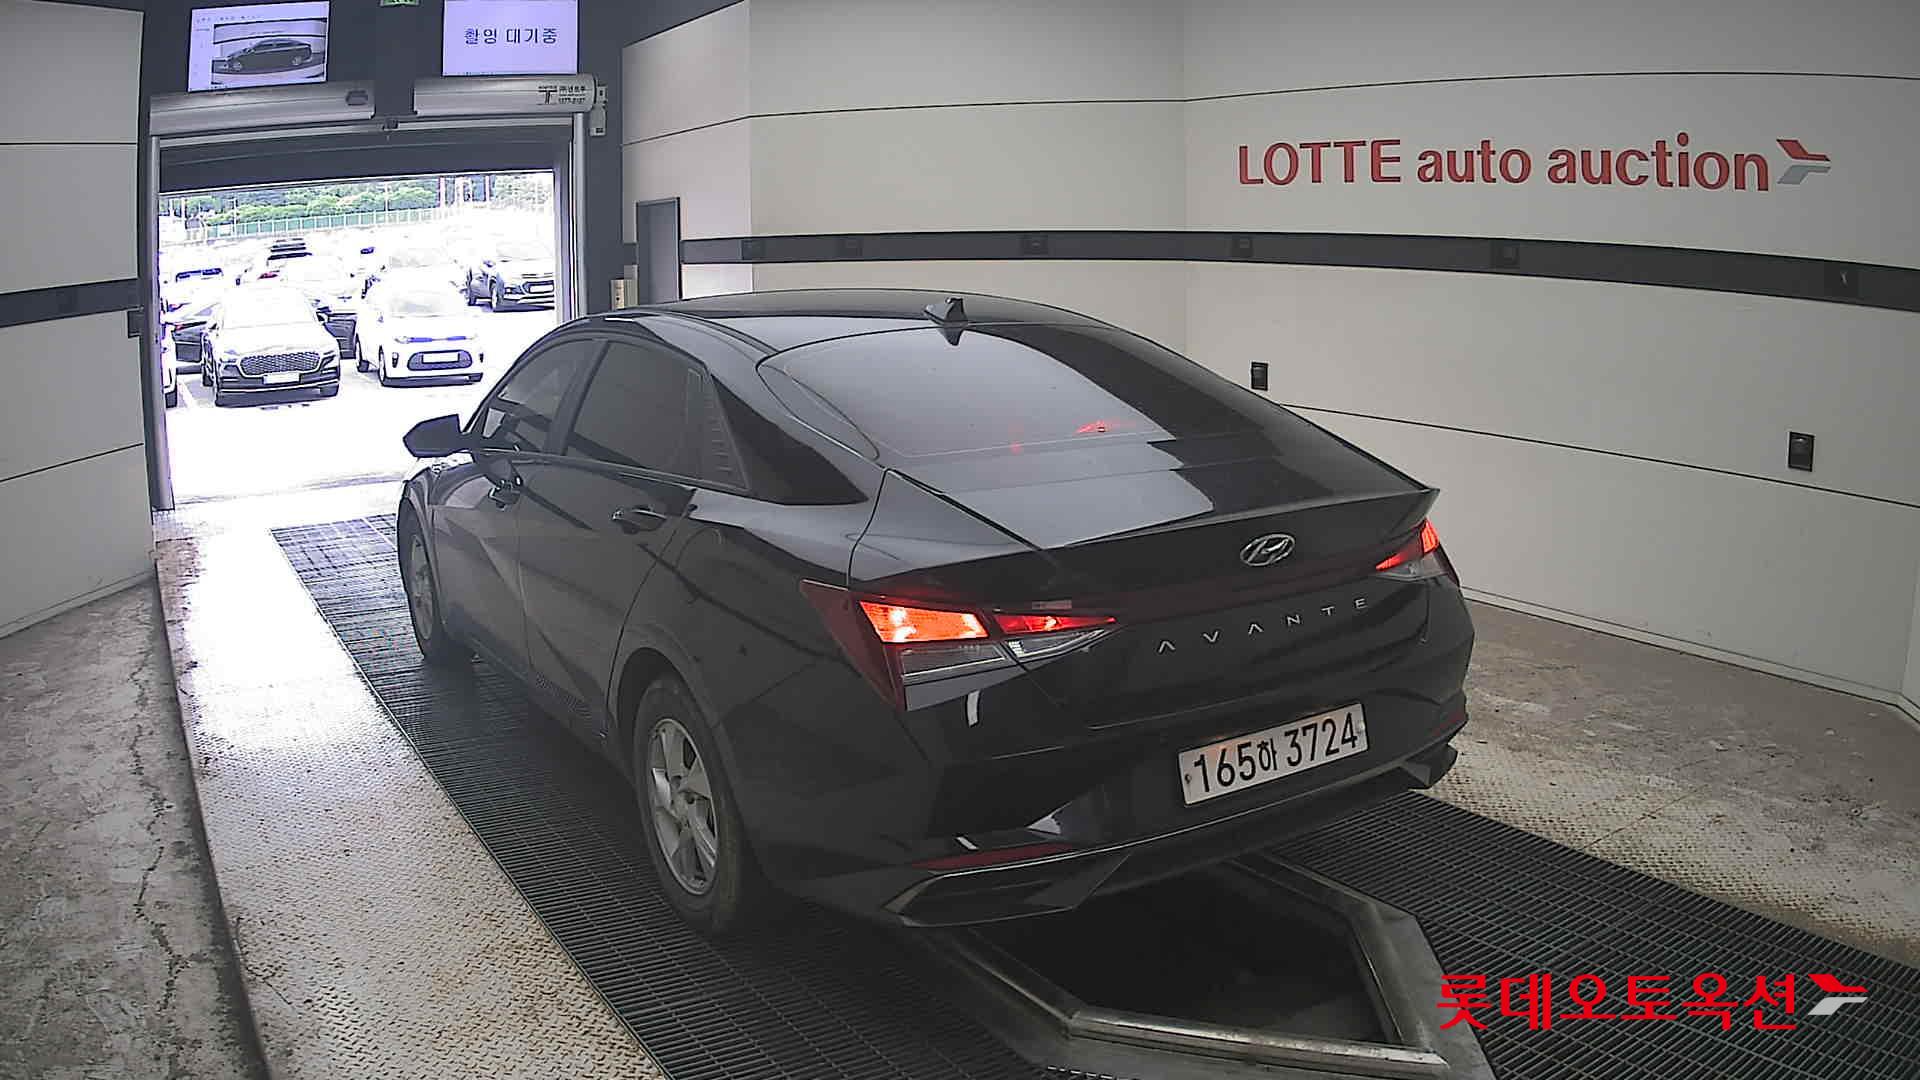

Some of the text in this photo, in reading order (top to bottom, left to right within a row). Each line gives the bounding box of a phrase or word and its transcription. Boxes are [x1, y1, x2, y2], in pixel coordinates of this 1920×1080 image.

[505, 28, 558, 44] 대기중
[1239, 131, 1770, 191] LOTTE auto auction
[1157, 597, 1368, 654] AVANTE
[1193, 712, 1358, 793] 165하 3724
